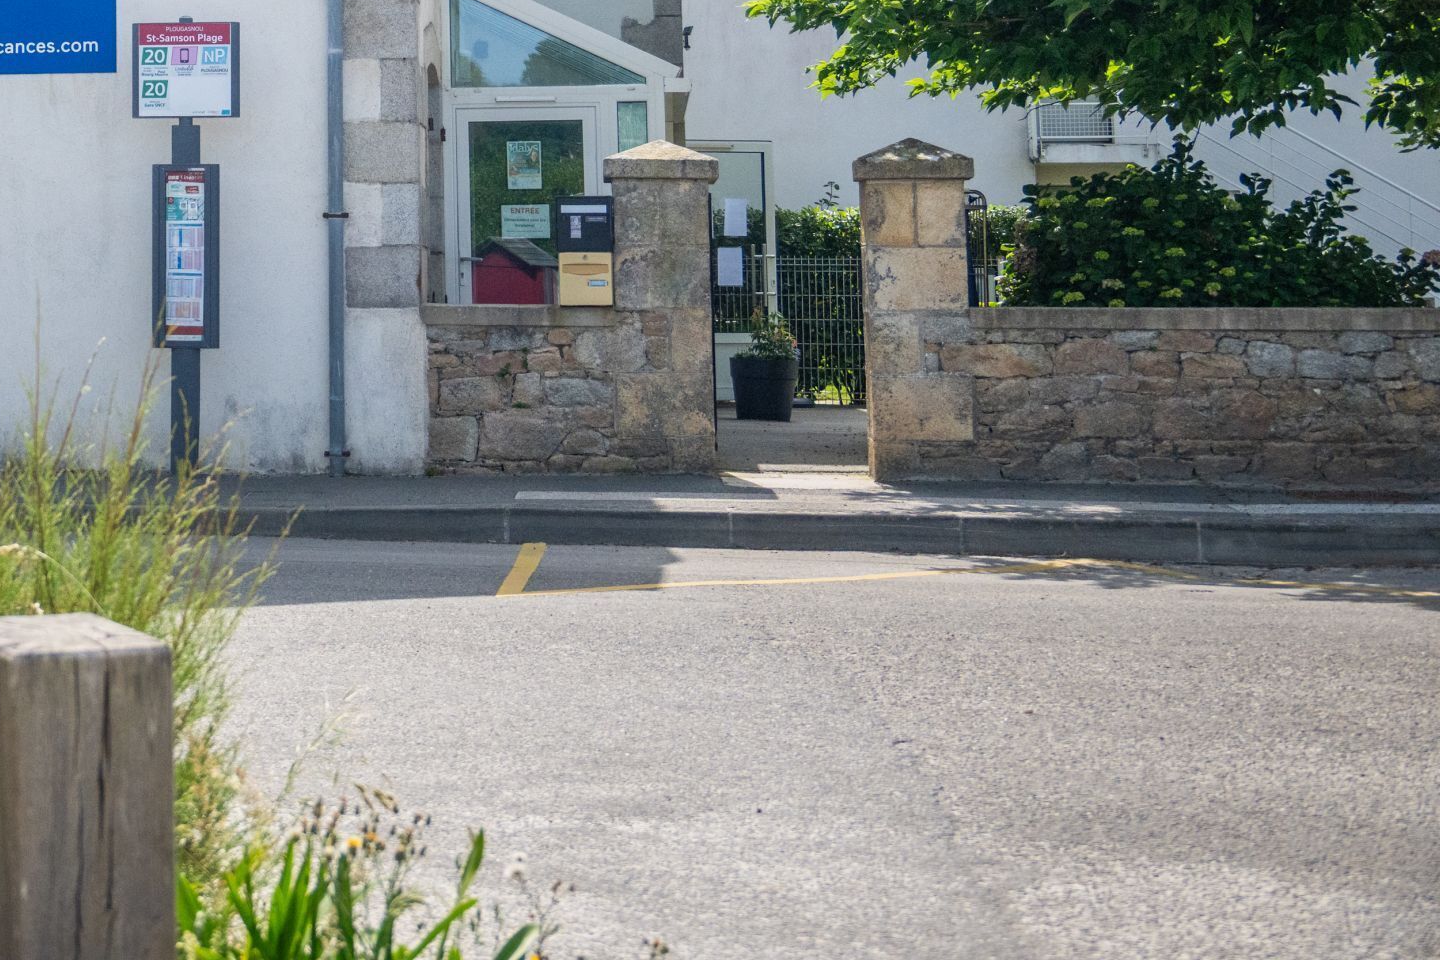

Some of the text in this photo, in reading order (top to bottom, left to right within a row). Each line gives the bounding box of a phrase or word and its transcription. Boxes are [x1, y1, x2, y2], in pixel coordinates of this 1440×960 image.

[146, 33, 223, 43] St-Samson Plage
[144, 49, 165, 63] 20
[204, 48, 225, 63] NP
[144, 82, 165, 97] 20
